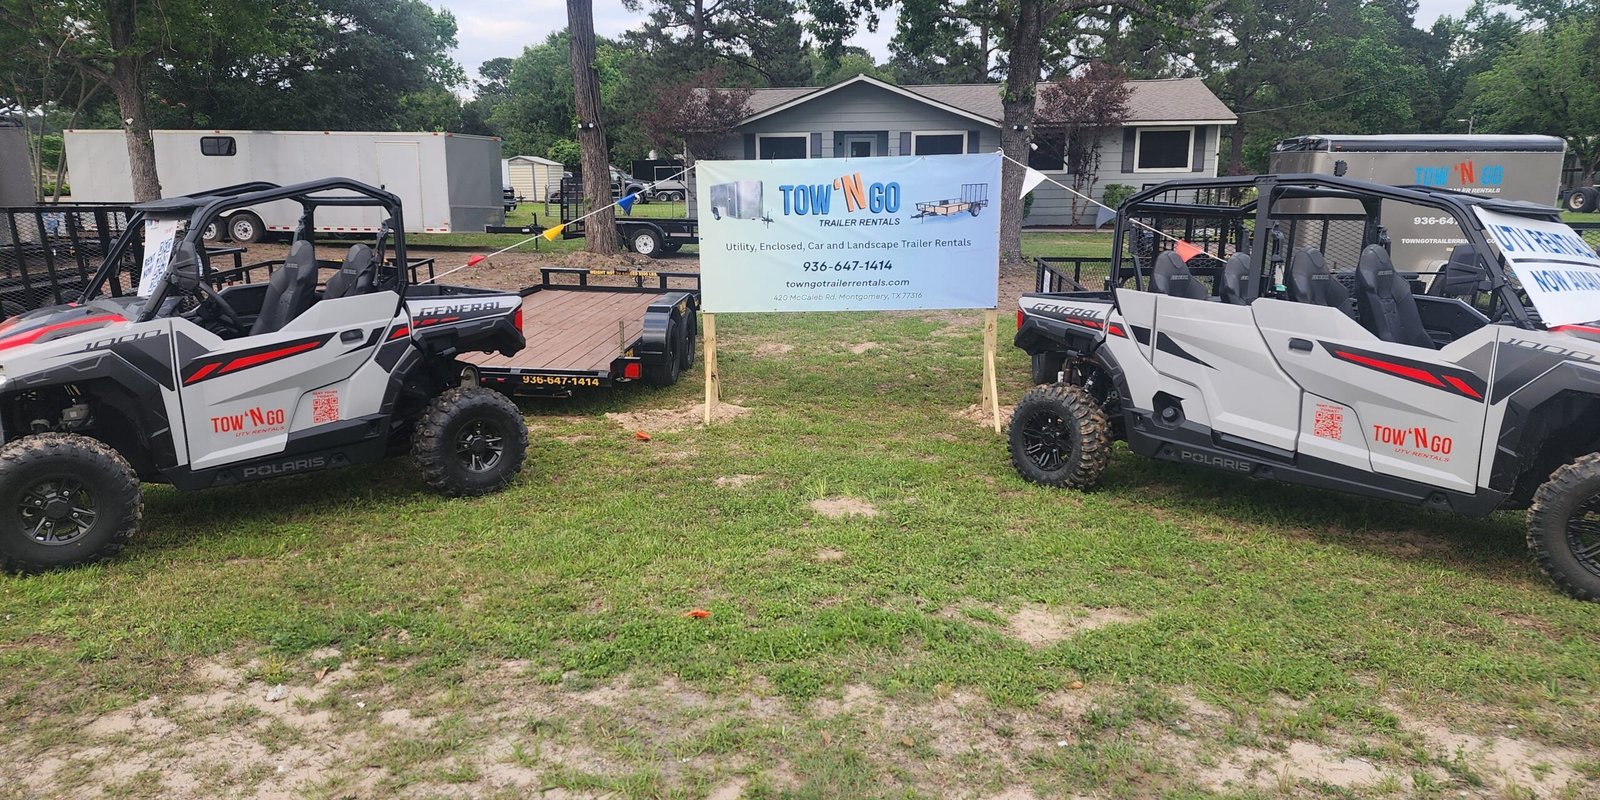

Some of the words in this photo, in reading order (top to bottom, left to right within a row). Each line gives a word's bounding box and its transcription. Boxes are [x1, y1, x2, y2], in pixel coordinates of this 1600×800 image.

[1415, 165, 1450, 186] TOW
[1481, 164, 1504, 186] GO
[779, 184, 832, 216] TOW
[869, 181, 901, 214] GO
[820, 219, 858, 227] TRAILER
[859, 217, 901, 226] RENTALS
[725, 242, 757, 253] Utility,
[759, 241, 806, 252] Enclosed,
[807, 241, 824, 250] Car
[826, 240, 845, 250] and
[847, 240, 899, 251] Landscape
[901, 239, 933, 248] Trailer
[935, 238, 972, 248] Rentals
[1487, 223, 1537, 252] UTV
[803, 260, 893, 272] 936-647-1414
[786, 278, 910, 290] towngotrailerrentals.com
[1530, 269, 1572, 293] NOW
[773, 294, 788, 302] 420
[790, 293, 824, 301] McCaleb
[839, 292, 890, 302] Montgomery,
[891, 292, 901, 300] TX
[902, 292, 923, 300] 77316
[419, 302, 501, 316] GENERAL
[1031, 302, 1102, 319] GENERAL
[85, 329, 162, 351] 1000
[1505, 337, 1596, 361] 1000
[522, 375, 600, 386] 936-647-1414
[211, 414, 243, 433] TOW
[266, 408, 285, 426] GO
[251, 425, 285, 436] RENTALS
[1373, 424, 1407, 446] TOW
[1431, 437, 1453, 455] GO
[1181, 450, 1251, 472] POLARIS
[1411, 451, 1450, 463] RENTALS
[243, 456, 325, 478] POLARIS
